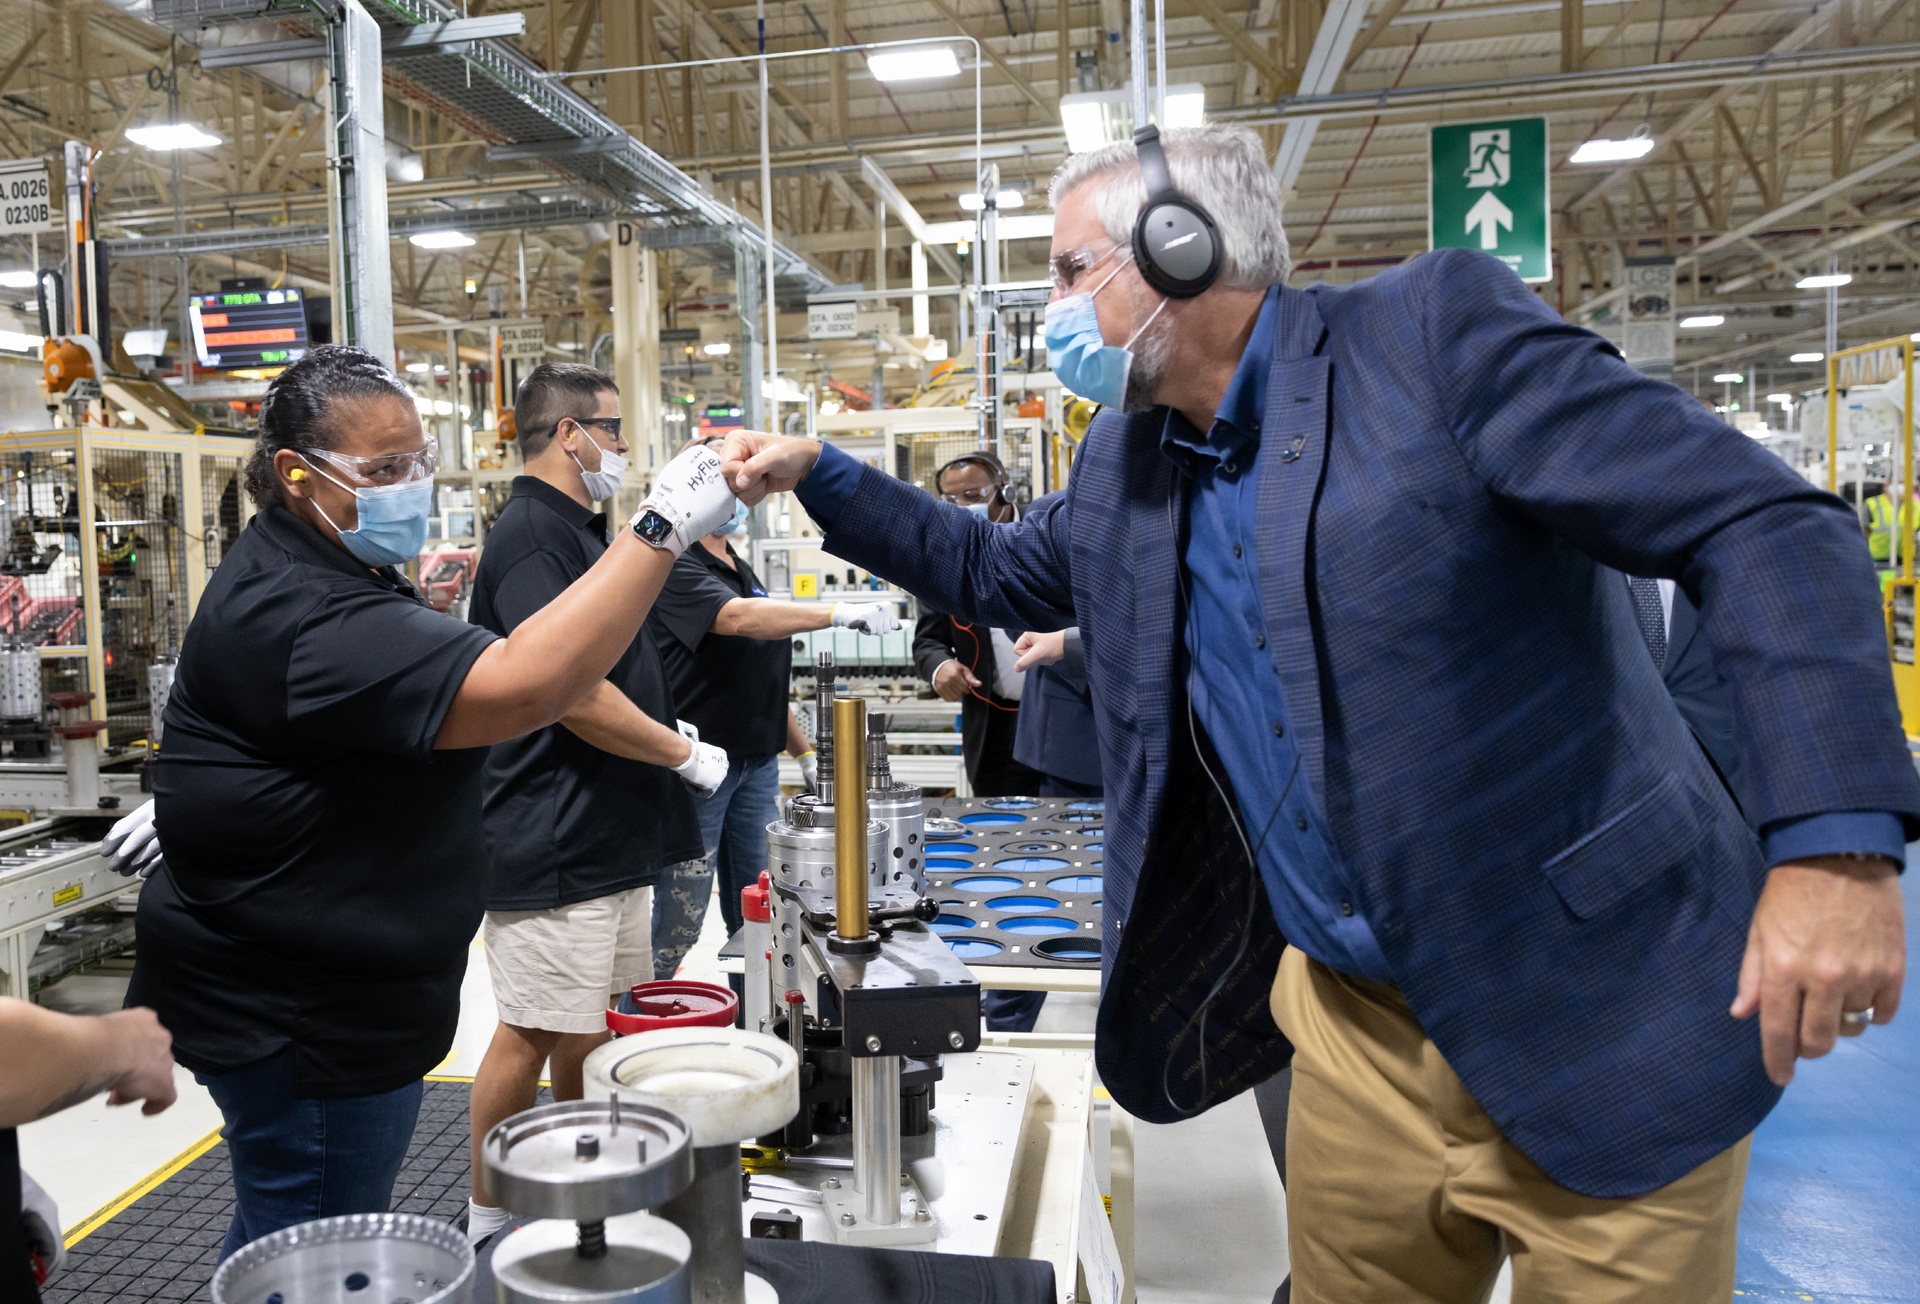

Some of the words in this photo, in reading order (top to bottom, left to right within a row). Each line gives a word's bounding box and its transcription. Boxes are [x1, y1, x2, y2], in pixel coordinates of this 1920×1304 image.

[12, 179, 47, 199] 0026
[6, 204, 49, 225] 0230B
[618, 223, 632, 246] D
[801, 579, 809, 592] F
